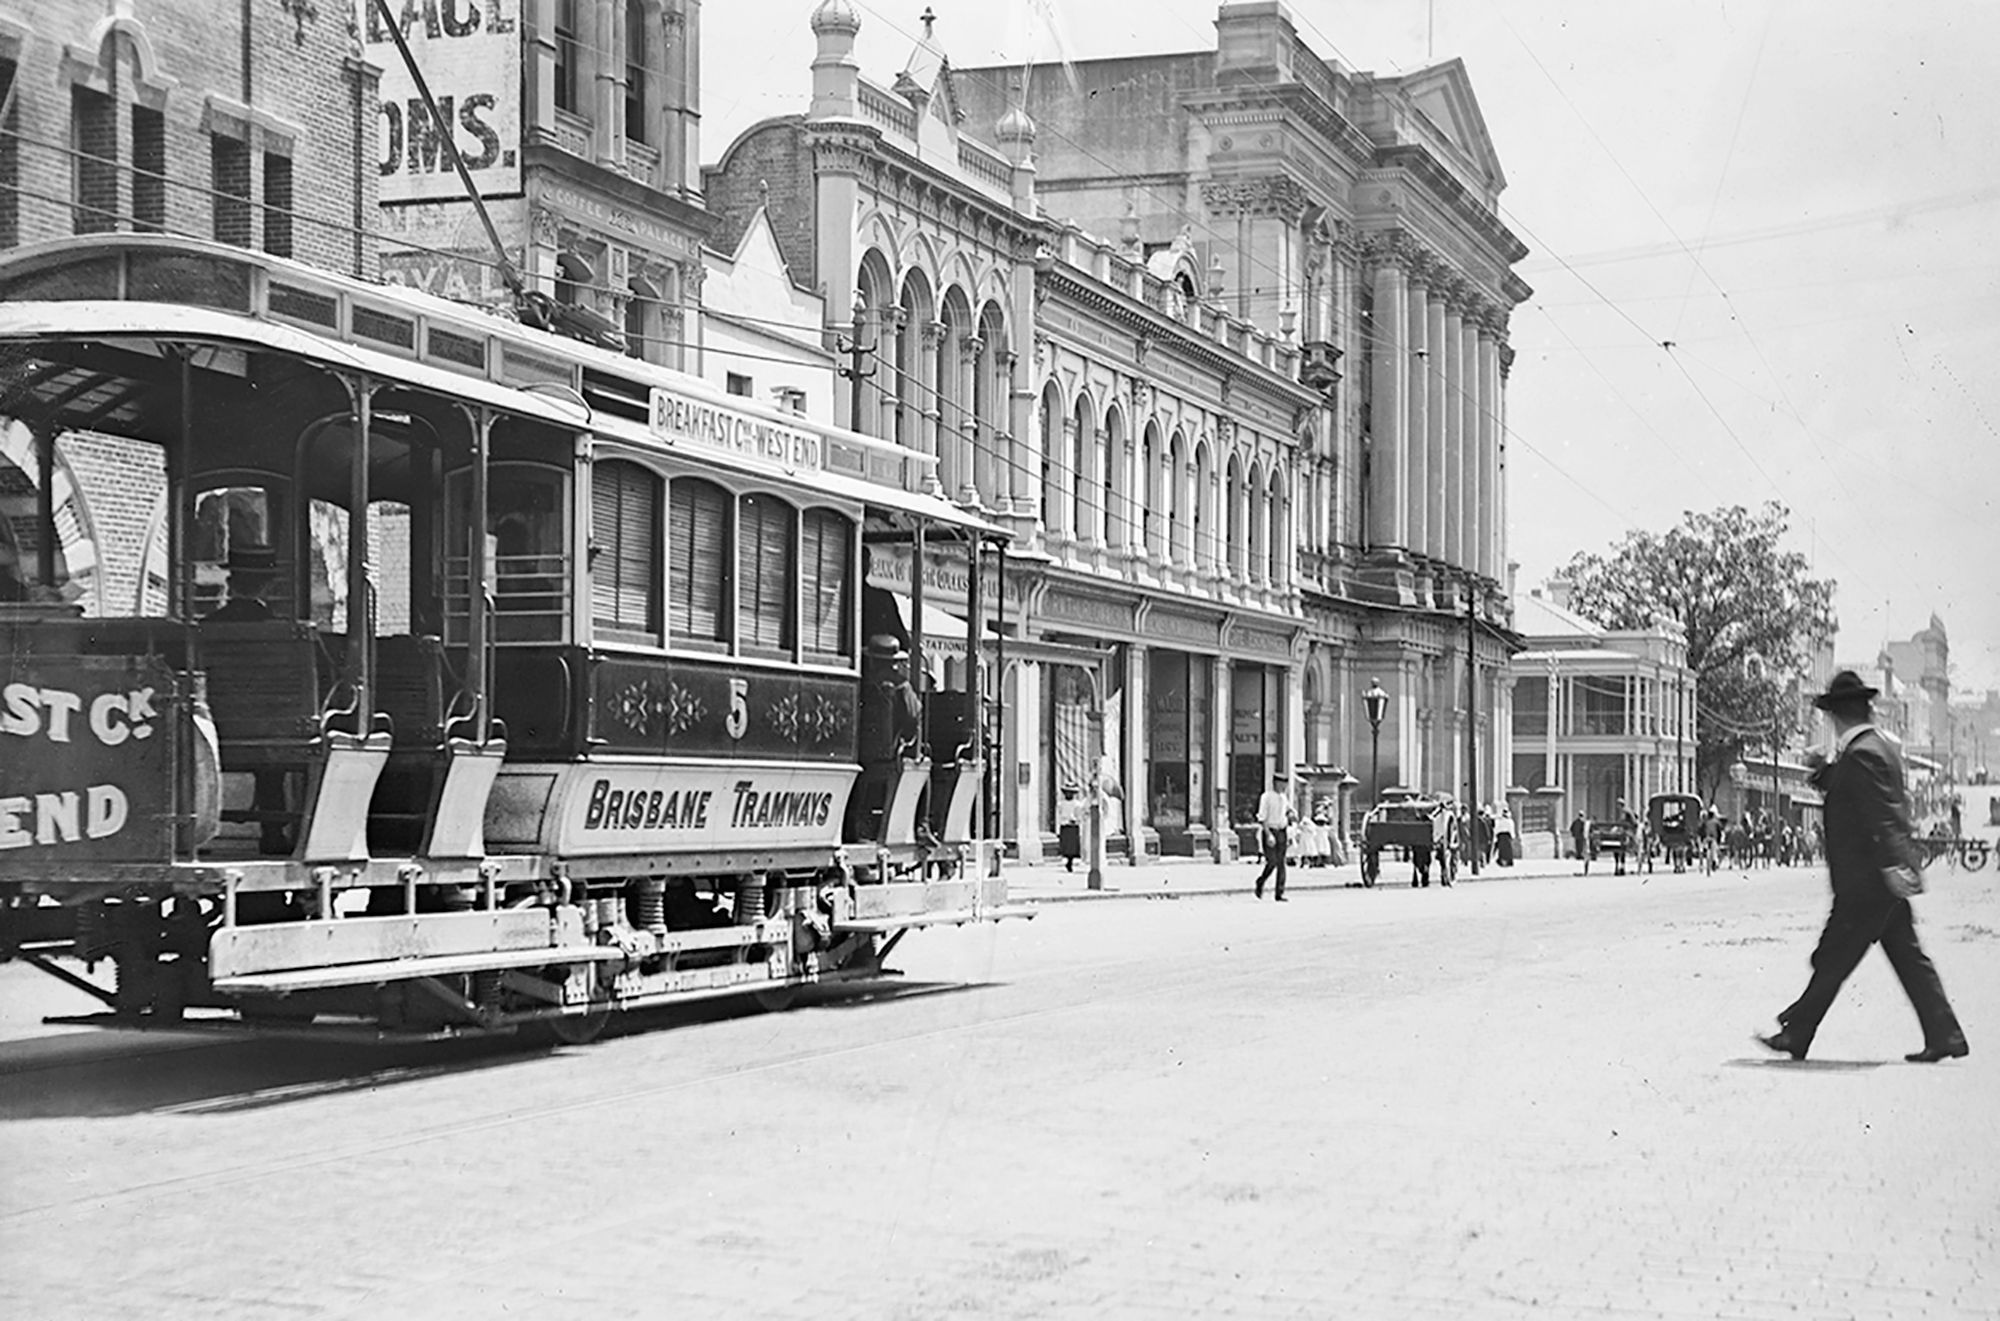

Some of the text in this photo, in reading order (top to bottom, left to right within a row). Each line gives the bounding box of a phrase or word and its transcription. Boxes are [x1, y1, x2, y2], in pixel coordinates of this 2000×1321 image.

[556, 188, 684, 249] COFFEE PALACE
[656, 395, 733, 449] BREAKFAST
[793, 435, 818, 467] END
[725, 678, 749, 740] 5
[0, 783, 129, 849] END
[584, 778, 833, 830] BRISBANE TRAMWAYS
